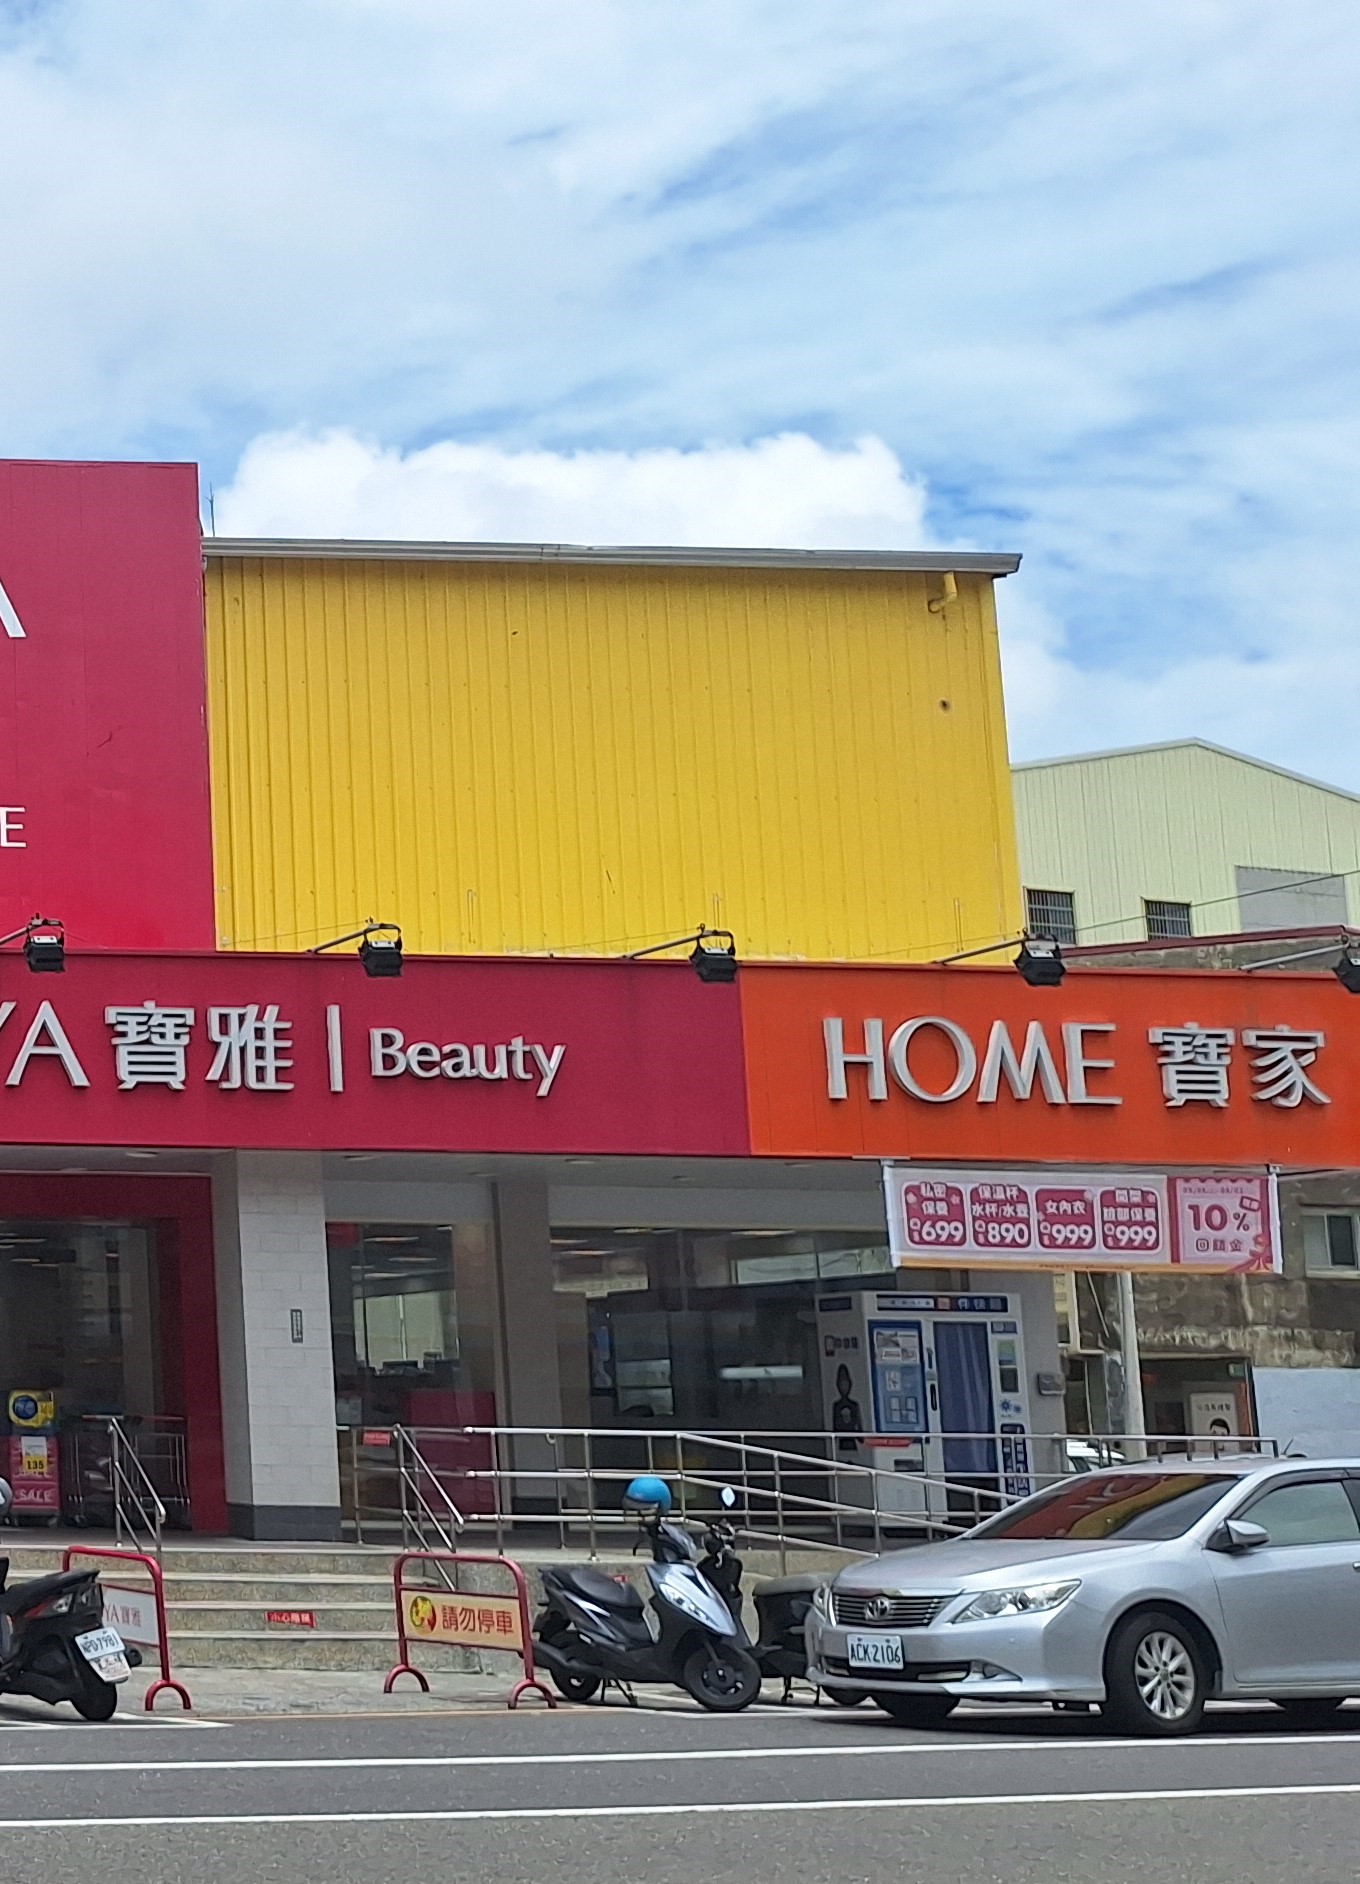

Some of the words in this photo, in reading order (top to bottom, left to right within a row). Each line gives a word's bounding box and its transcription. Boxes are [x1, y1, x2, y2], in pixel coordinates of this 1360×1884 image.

[104, 1000, 295, 1092] 寶雅
[370, 1026, 567, 1098] Beauty
[823, 1015, 1123, 1105] HOME
[1148, 1021, 1332, 1109] 寶家
[1187, 1203, 1251, 1232] 10%
[921, 1220, 964, 1242] 699
[987, 1222, 1029, 1244] 890
[1051, 1224, 1094, 1247] 999
[1115, 1225, 1157, 1248] 999
[441, 1604, 515, 1635] 請勿停車
[850, 1643, 901, 1664] ACK-2106
